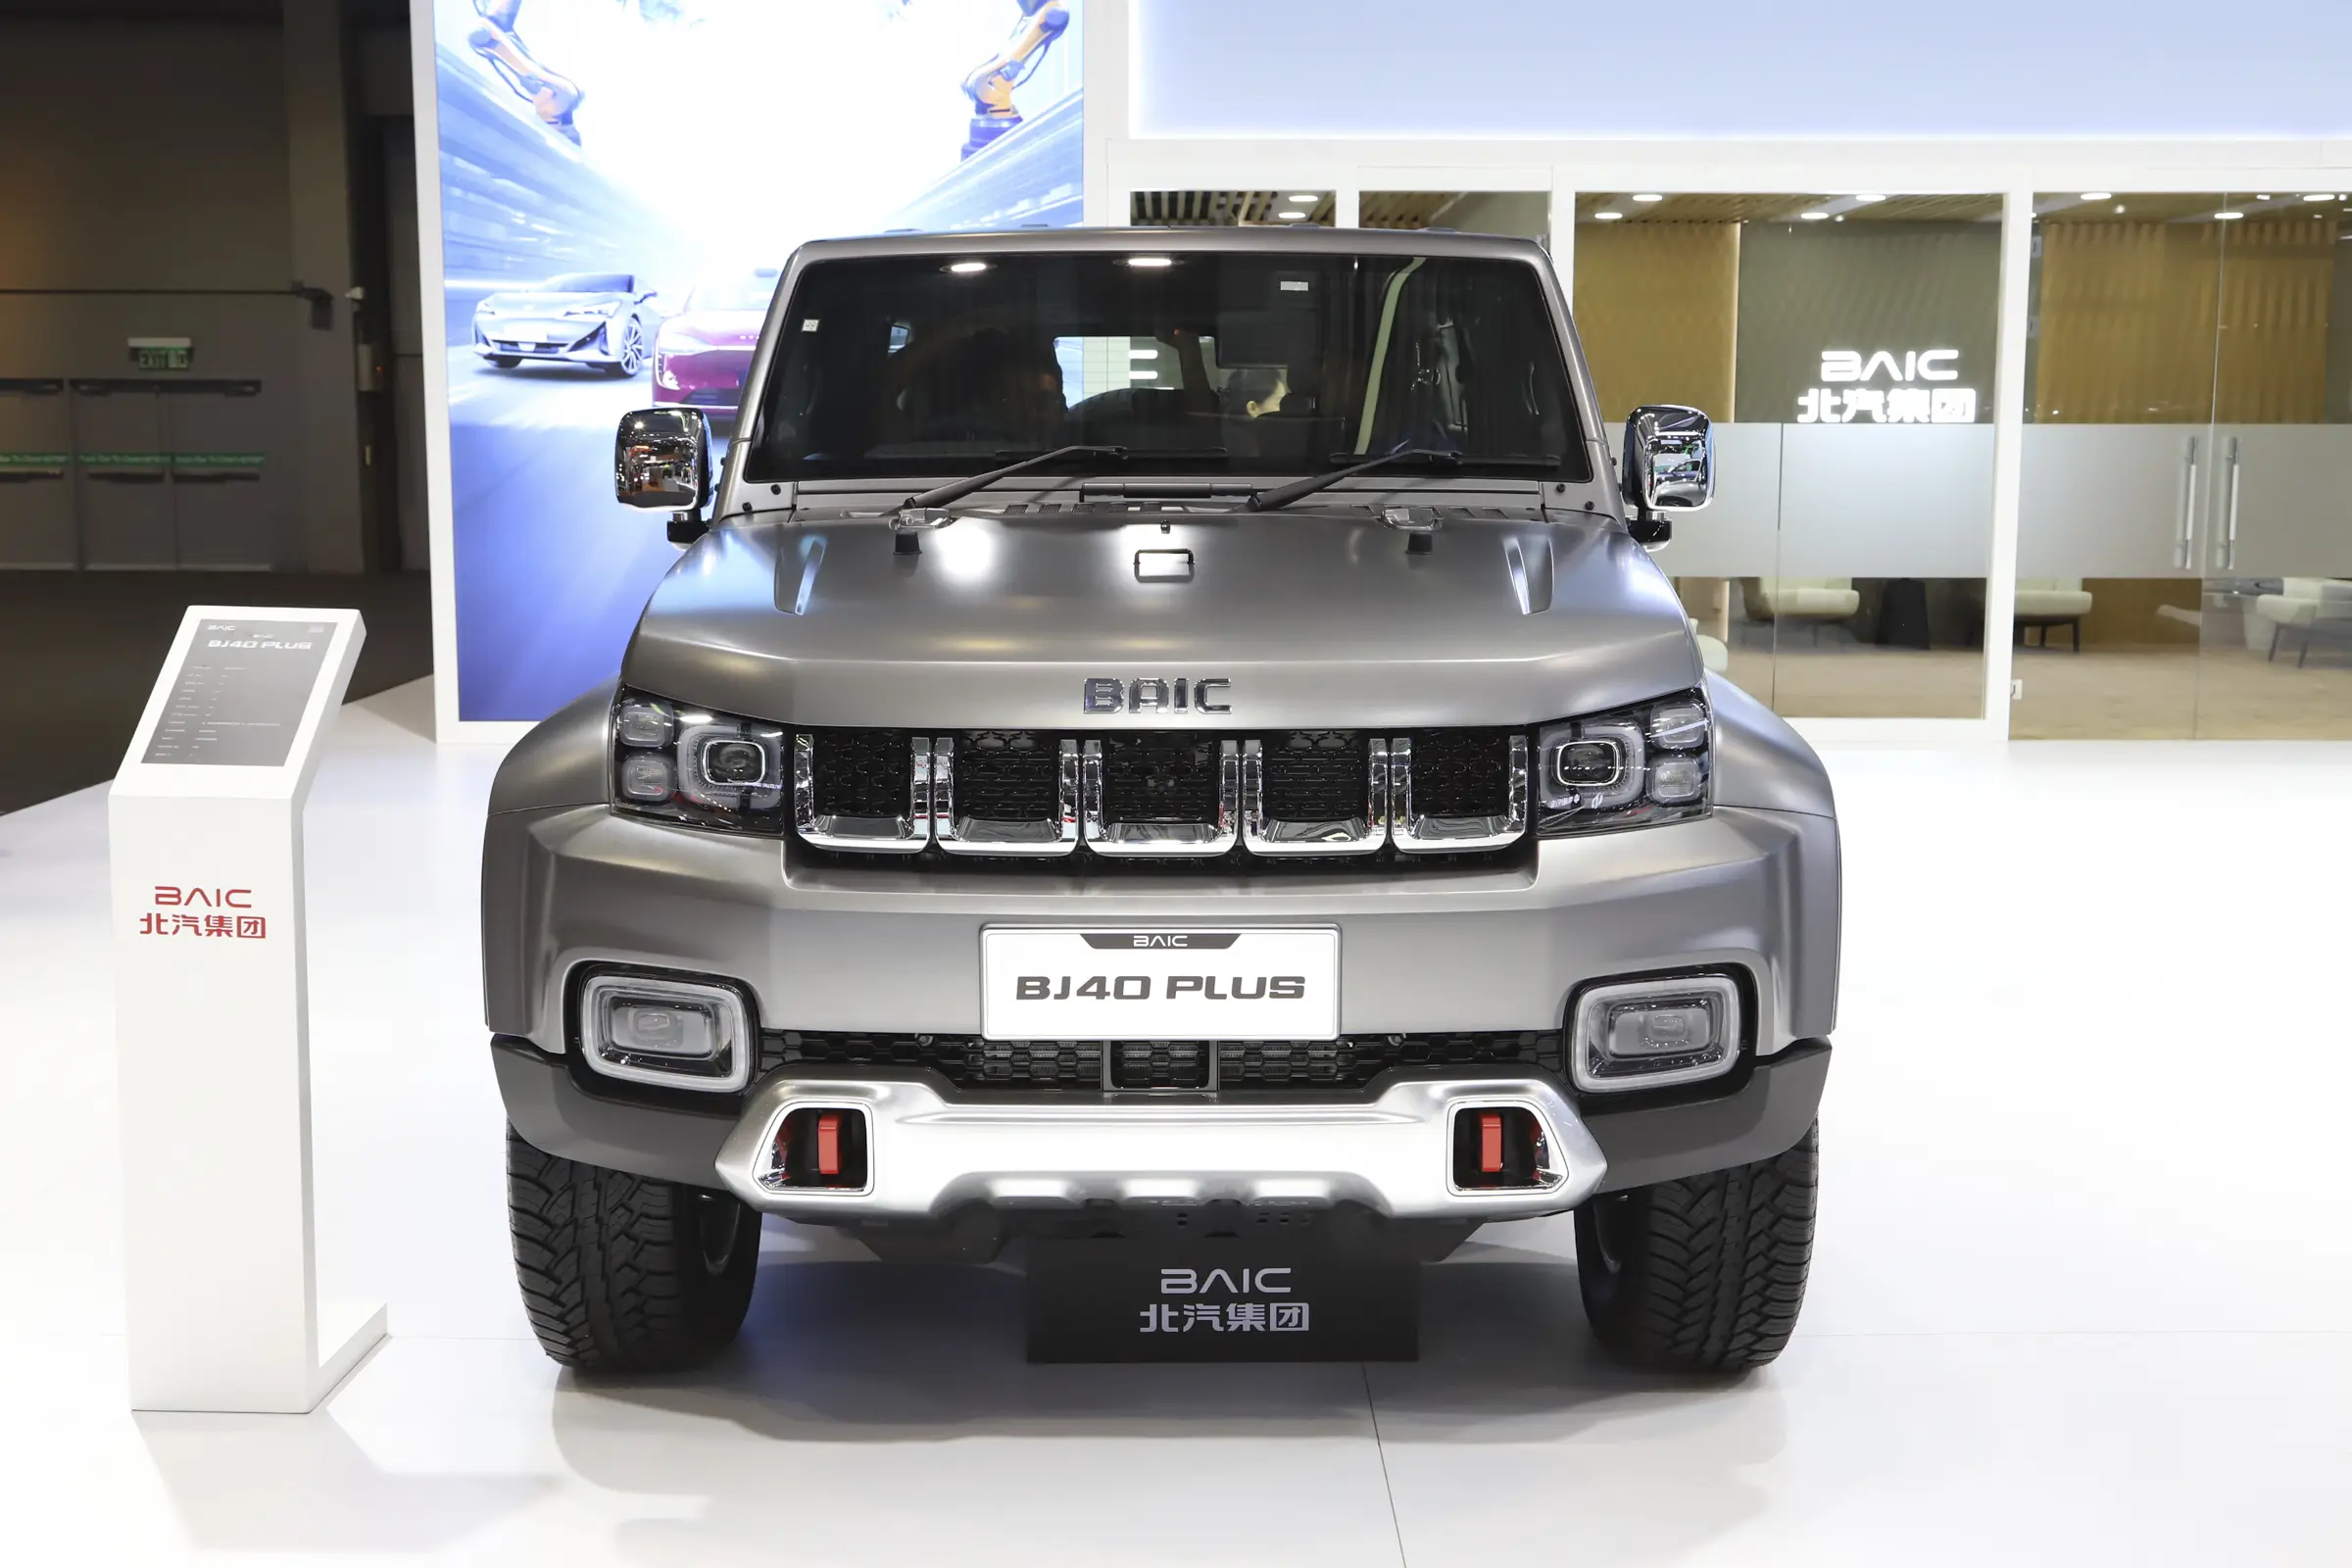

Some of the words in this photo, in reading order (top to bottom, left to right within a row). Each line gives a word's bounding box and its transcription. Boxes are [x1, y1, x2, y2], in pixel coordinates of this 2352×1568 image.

[1820, 349, 1960, 382] BAIC
[1796, 387, 1977, 422] 北汽集团
[207, 639, 259, 649] BJ40
[260, 641, 313, 650] PLUS
[1083, 677, 1233, 714] BAIC
[155, 885, 252, 908] BAIC
[140, 912, 267, 939] 北汽集团
[1132, 934, 1189, 948] BAIC
[1015, 976, 1152, 1001] BJ40
[1166, 976, 1306, 1001] PLUS
[1160, 1267, 1292, 1294] BAIC
[1139, 1302, 1309, 1333] 北汽集团
